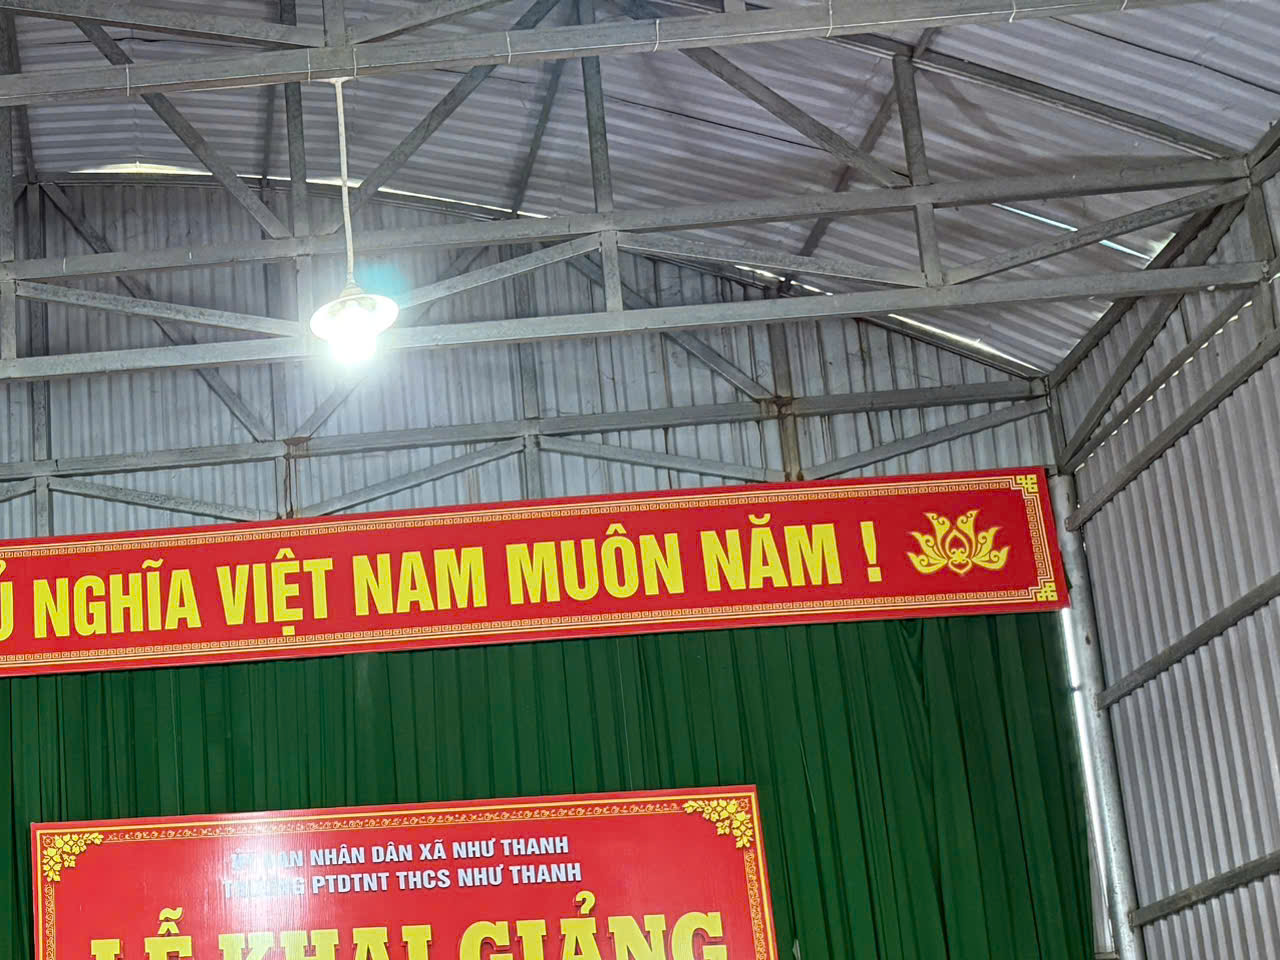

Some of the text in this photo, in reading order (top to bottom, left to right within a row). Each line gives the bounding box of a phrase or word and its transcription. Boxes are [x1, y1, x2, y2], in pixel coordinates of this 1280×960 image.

[32, 559, 201, 638] NGHĨA
[216, 547, 333, 635] VIỆT
[352, 546, 488, 617] NAM
[505, 524, 678, 605] MUÔN
[699, 514, 843, 592] NĂM
[861, 521, 882, 582] !
[310, 844, 365, 867] NHÂN
[372, 841, 413, 863] DÂN
[419, 839, 446, 860] XÃ
[452, 838, 496, 858] NHƯ
[501, 836, 569, 856] THANH
[312, 872, 389, 895] PTDTNT
[396, 869, 450, 889] THCS
[457, 864, 504, 887] NHƯ
[509, 863, 582, 884] THANH
